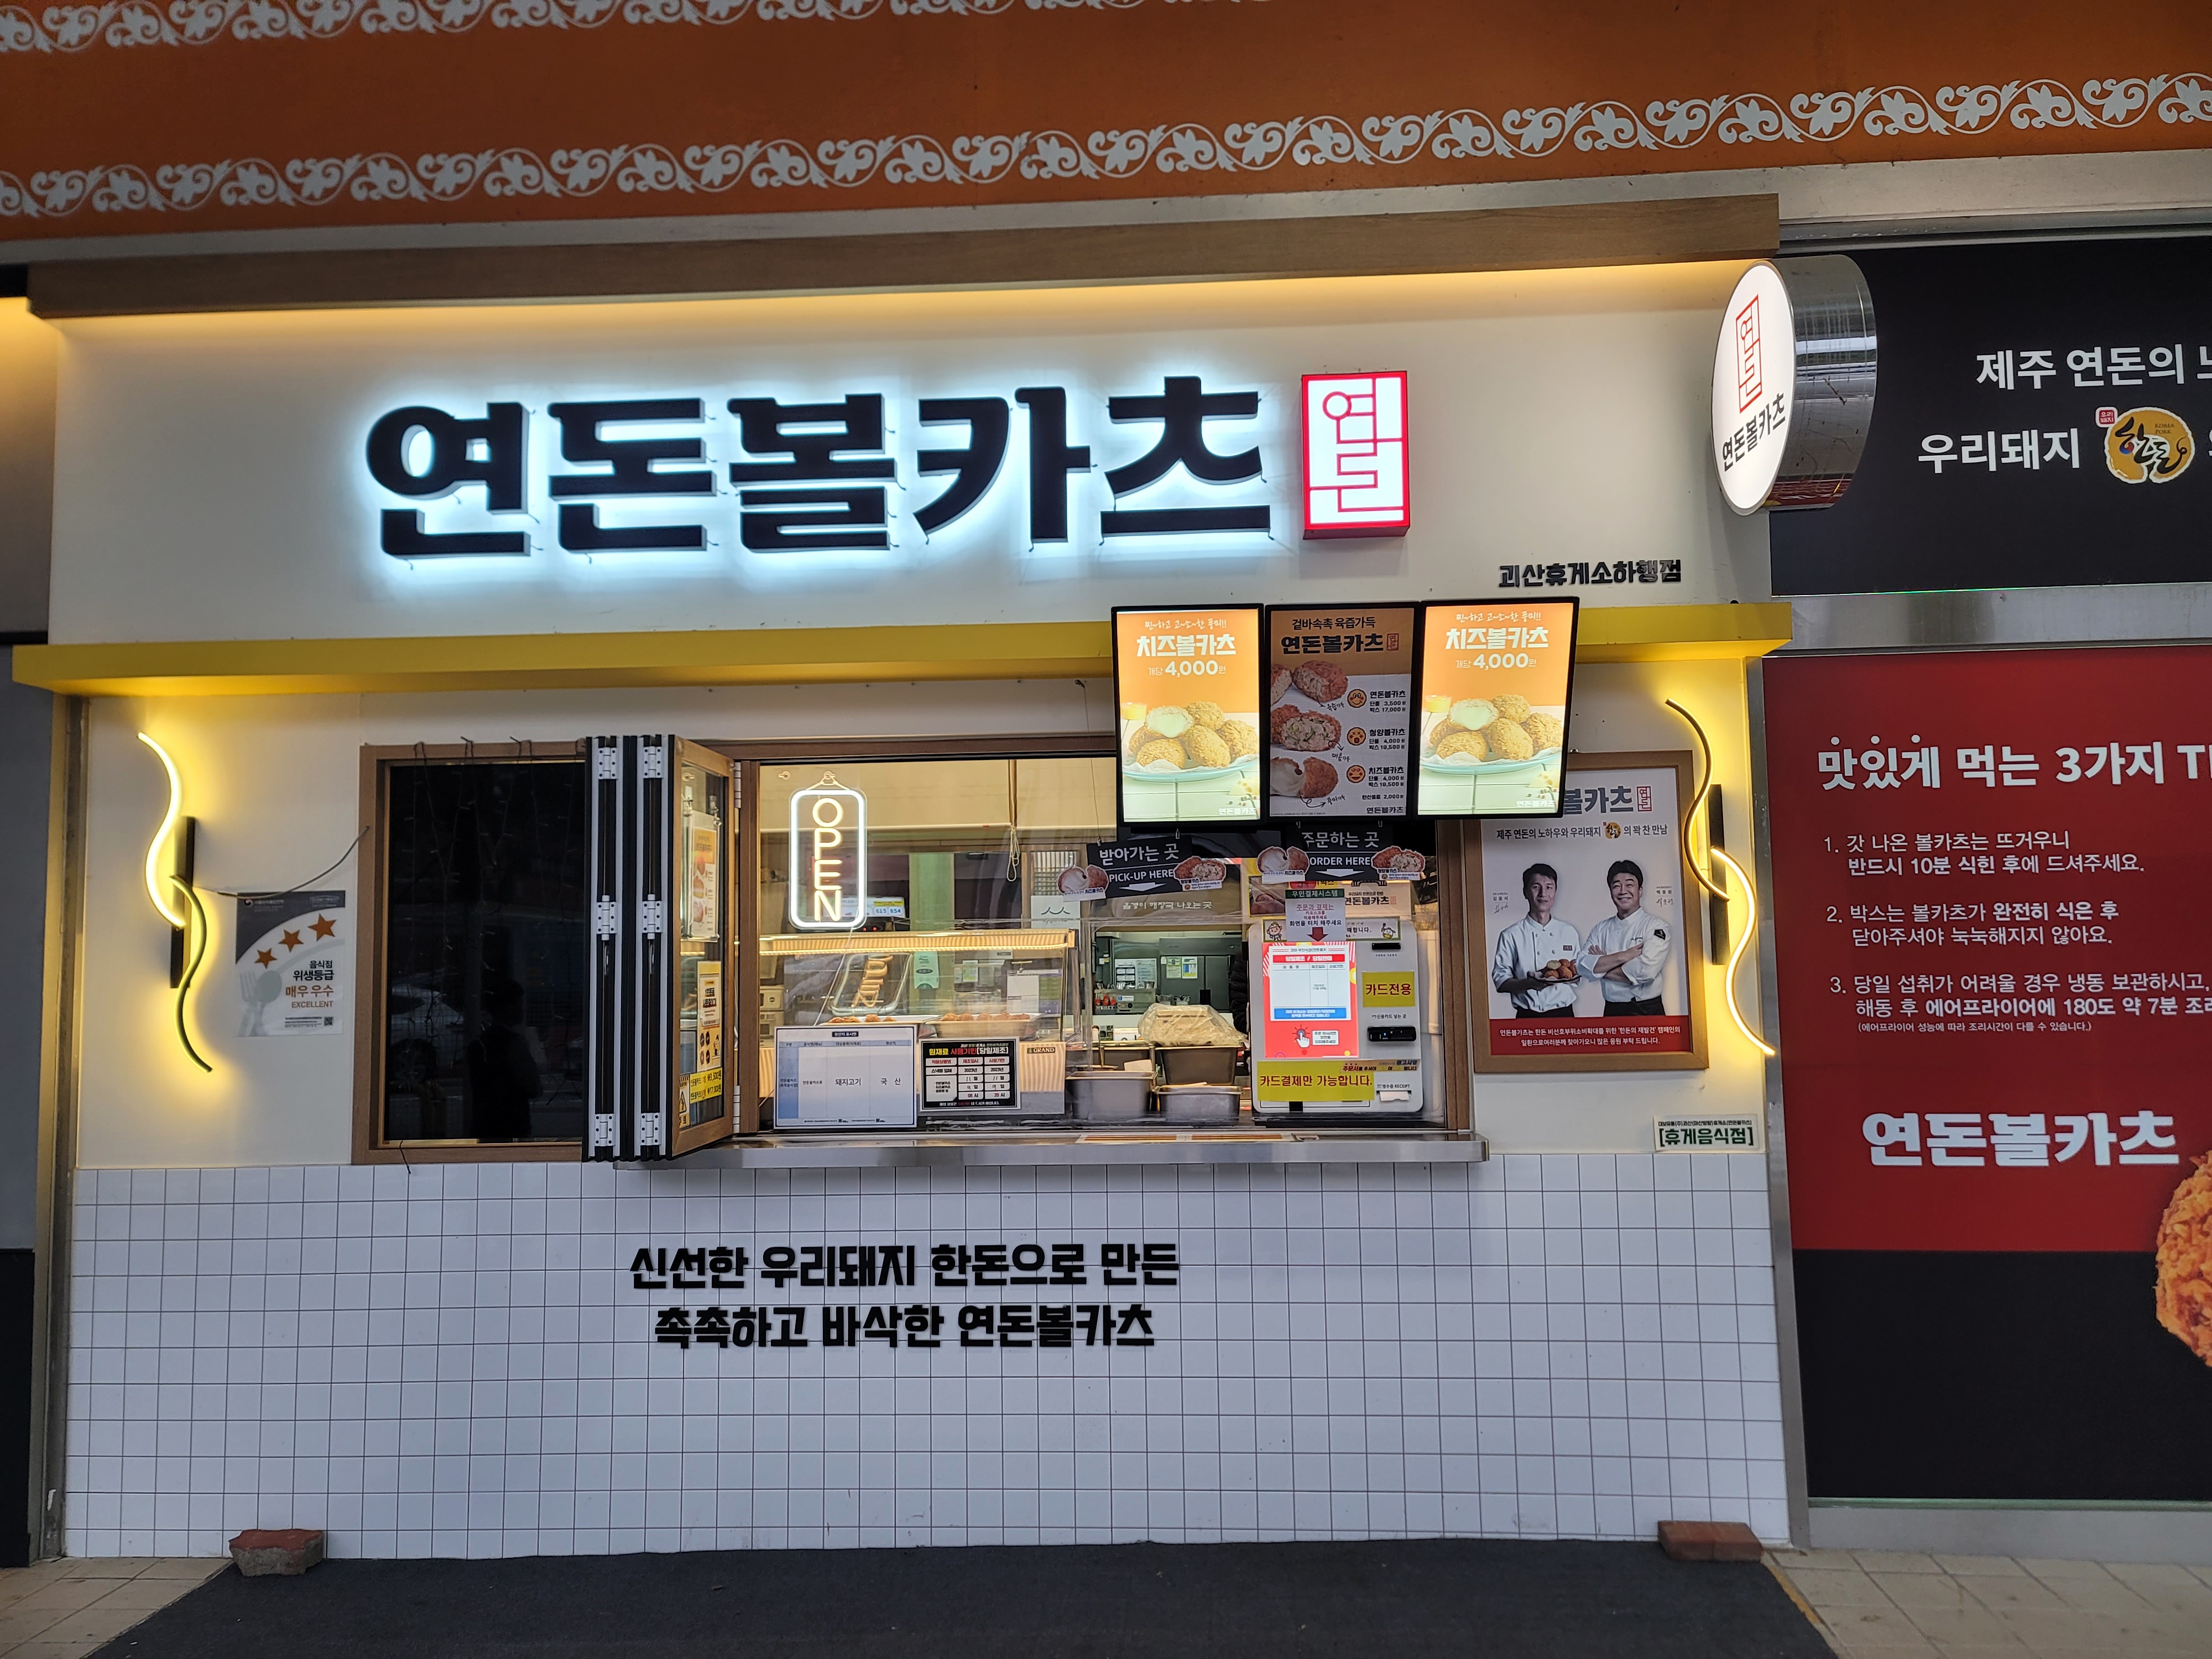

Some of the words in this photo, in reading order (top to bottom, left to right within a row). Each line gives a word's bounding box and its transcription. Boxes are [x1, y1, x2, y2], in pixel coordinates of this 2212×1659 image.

[1976, 350, 2056, 389] 제주
[2067, 343, 2184, 387] 연돈의
[1722, 392, 1785, 472] 연돈볼카츠
[1918, 428, 2079, 473] 우리돼지
[367, 376, 1270, 559] 연돈볼카츠
[1499, 559, 1681, 588] 괴산휴게소하행점
[1292, 618, 1333, 630] 겉바속촉
[1334, 617, 1376, 629] 육즙가득
[1136, 634, 1237, 657] 치즈볼카츠
[1281, 633, 1384, 655] 연돈볼카츠
[1445, 627, 1549, 649] 치즈볼카츠
[1147, 667, 1163, 676] 개당
[1455, 660, 1471, 669] 개당
[1370, 690, 1406, 699] 연돈볼카츠
[1369, 728, 1405, 737] 청양볼카츠
[1818, 741, 1940, 790] 맛있게
[1957, 744, 2039, 787] 먹는
[2056, 741, 2164, 785] 3가지
[1563, 786, 1634, 815] 볼카츠
[1302, 831, 1360, 848] 주문하는
[1364, 832, 1379, 848] 곳
[1496, 829, 1512, 840] 제주
[1514, 828, 1536, 839] 연돈의
[1538, 827, 1569, 838] 노하우와
[1570, 826, 1601, 838] 우리돼지
[1624, 826, 1631, 836] 의
[1632, 826, 1641, 836] 꽉
[1642, 825, 1651, 836] 찬
[1652, 824, 1668, 835] 만남
[1825, 836, 1839, 852] 1.
[1846, 834, 1864, 853] 갓
[1872, 833, 1907, 852] 나온
[1916, 832, 1989, 852] 볼카츠는
[1996, 830, 2070, 851] 뜨거우니
[812, 797, 843, 921] OPEN
[1099, 847, 1160, 866] 받아가는
[1164, 843, 1179, 860] 곳
[1310, 857, 1344, 866] ORDER
[1345, 857, 1370, 865] HERE
[1849, 857, 1903, 876] 반드시
[1911, 856, 1950, 875] 10분
[1959, 855, 1995, 874] 식힌
[2002, 854, 2039, 874] 후에
[2047, 853, 2145, 873] 드셔주세요.
[1109, 871, 1147, 883] PICK-UP
[1150, 868, 1173, 879] HERE
[1176, 901, 1201, 910] 나오는
[1345, 896, 1390, 905] 연돈볼카츠
[1827, 906, 1843, 923] 2.
[1850, 904, 1905, 923] 박스는
[1912, 902, 1986, 922] 볼카츠가
[1992, 902, 2048, 921] 완전히
[2056, 901, 2093, 921] 식은
[2100, 901, 2119, 920] 후
[1853, 928, 1944, 947] 닫아주셔야
[1951, 926, 2044, 946] 눅눅해지지
[2051, 925, 2112, 945] 않아요.
[310, 960, 333, 969] 음식점
[293, 970, 335, 982] 위생등급
[1830, 977, 1846, 994] 3.
[1854, 975, 1890, 994] 당일
[1897, 974, 1953, 994] 섭취가
[1960, 974, 2016, 993] 어려울
[2023, 974, 2059, 993] 경우
[2068, 973, 2104, 993] 냉동
[2112, 972, 2209, 993] 보관하시고,
[285, 985, 309, 998] 매우
[311, 984, 334, 997] 우수
[1365, 983, 1412, 996] 카드전용
[291, 1000, 333, 1009] EXCELLENT
[1856, 998, 1892, 1018] 해동
[1900, 998, 1919, 1017] 후
[1926, 998, 2056, 1017] 에어프라이어에
[2064, 997, 2116, 1016] 180도
[2123, 997, 2141, 1016] 약
[2147, 996, 2178, 1015] 7분
[1858, 1022, 1914, 1032] (에어프라이어
[1917, 1022, 1944, 1032] 성능에
[1948, 1022, 1965, 1032] 따라
[1969, 1022, 2013, 1032] 조리시간이
[2016, 1022, 2034, 1031] 다를
[2037, 1022, 2047, 1031] 수
[2049, 1021, 2091, 1031] 있습니다.)
[1568, 1037, 1596, 1046] 찾아가오니
[894, 1077, 901, 1086] 산
[1260, 1075, 1313, 1087] 카드결제만
[1317, 1074, 1373, 1087] 가능합니다.
[1659, 1126, 1754, 1147] [휴게음식점]
[1862, 1109, 2179, 1167] 연돈볼카츠
[630, 1244, 748, 1289] 신선한
[761, 1245, 915, 1287] 우리돼지
[932, 1243, 1087, 1287] 한돈으로
[1101, 1243, 1179, 1286] 만든
[655, 1306, 808, 1348] 촉촉하고
[824, 1304, 944, 1347] 바삭한
[958, 1303, 1154, 1347] 연돈볼카츠
